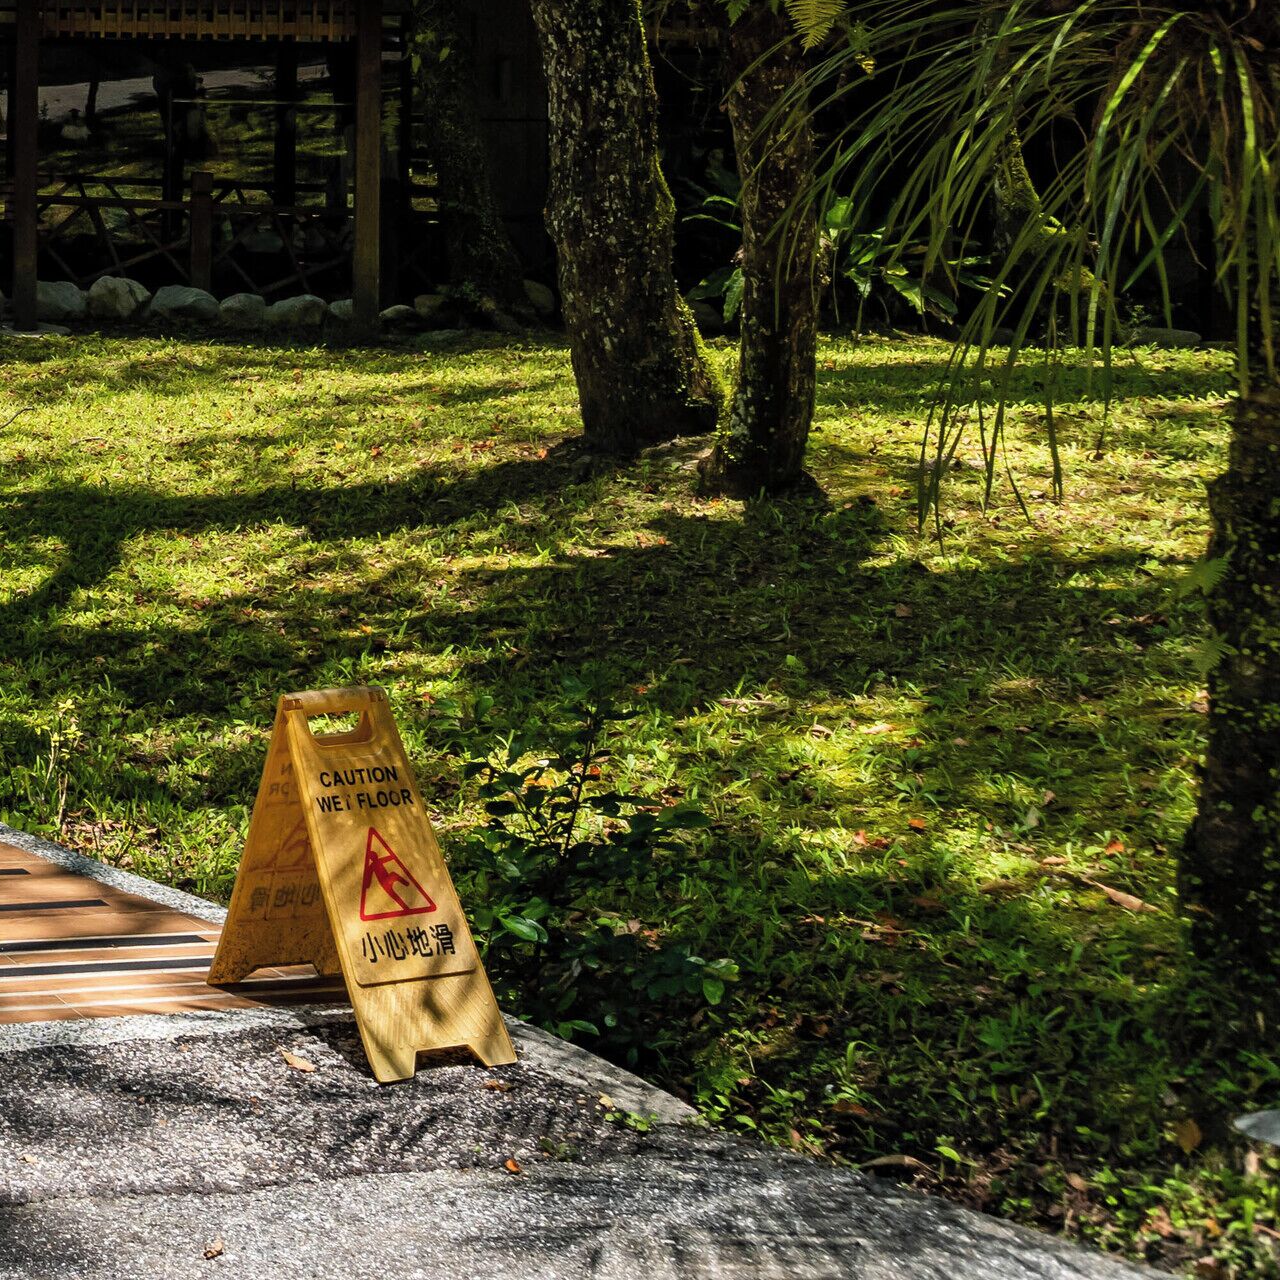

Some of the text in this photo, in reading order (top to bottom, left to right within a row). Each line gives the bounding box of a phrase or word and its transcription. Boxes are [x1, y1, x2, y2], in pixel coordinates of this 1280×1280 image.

[320, 766, 398, 787] CAUTION
[356, 789, 413, 809] FLOOR
[362, 924, 456, 963] 小心地滑
